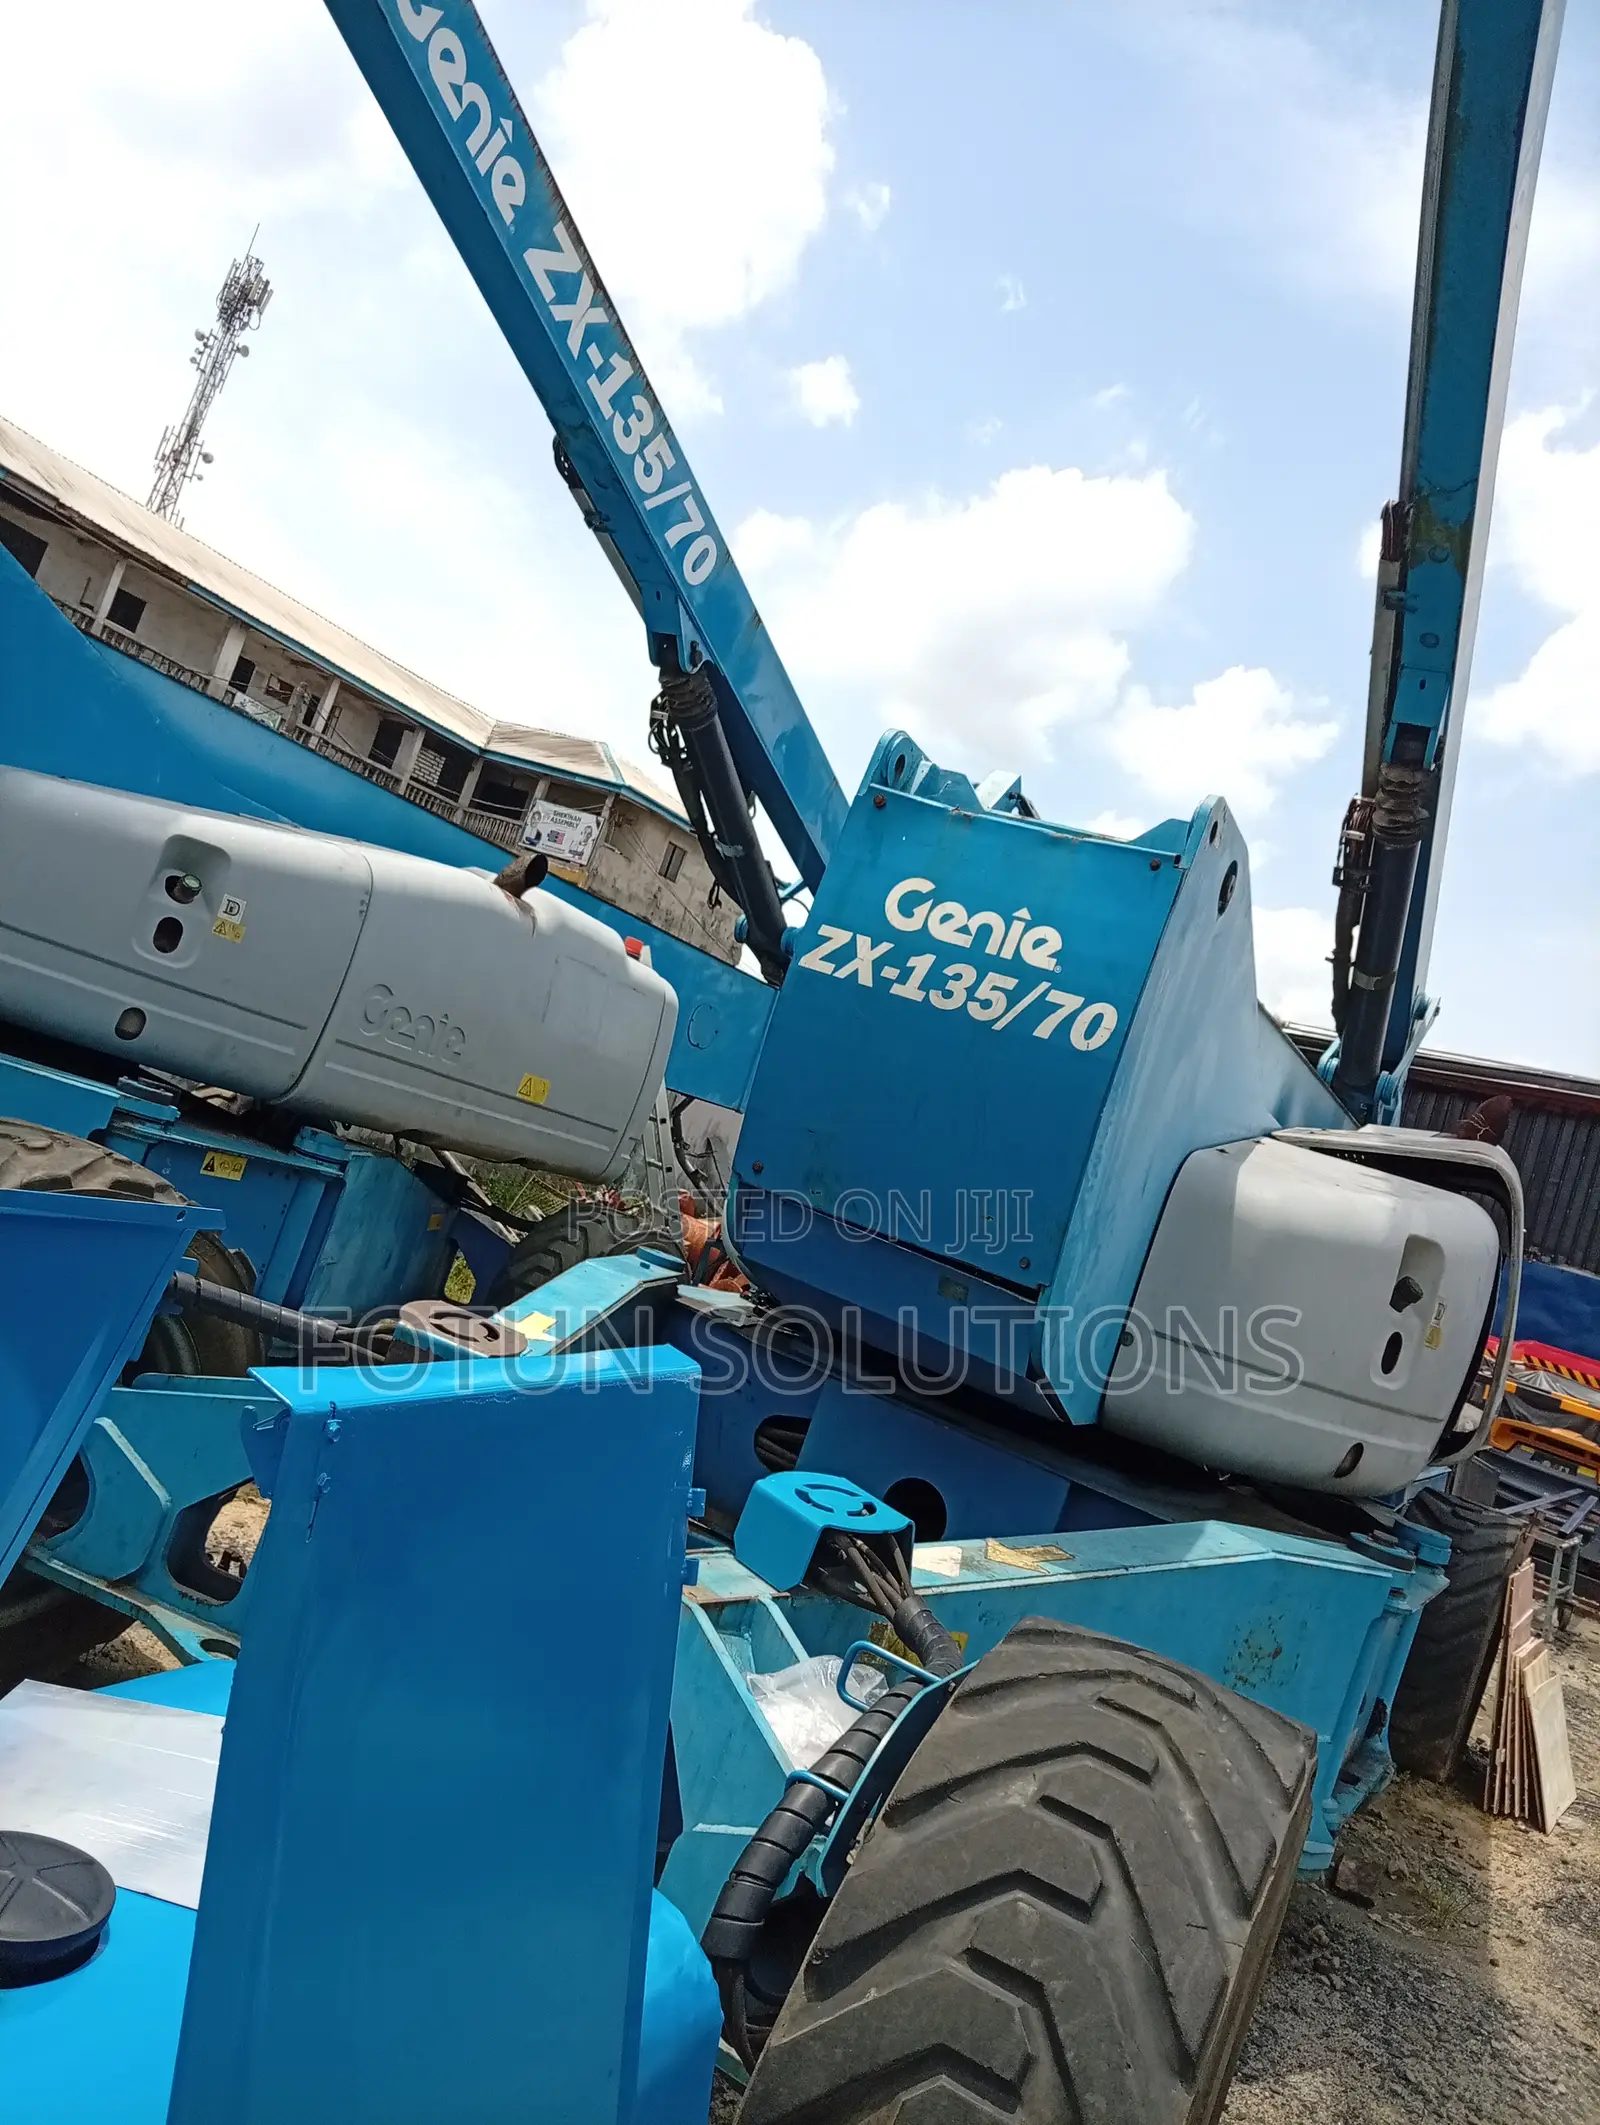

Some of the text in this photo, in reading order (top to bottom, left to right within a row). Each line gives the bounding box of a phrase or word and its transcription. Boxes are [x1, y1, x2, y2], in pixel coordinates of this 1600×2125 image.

[523, 221, 717, 586] ZX-135/70
[550, 816, 580, 829] ASSEMBLY
[885, 877, 1062, 972] Genie
[358, 984, 467, 1064] Genie
[799, 924, 1118, 1052] ZX-135/70
